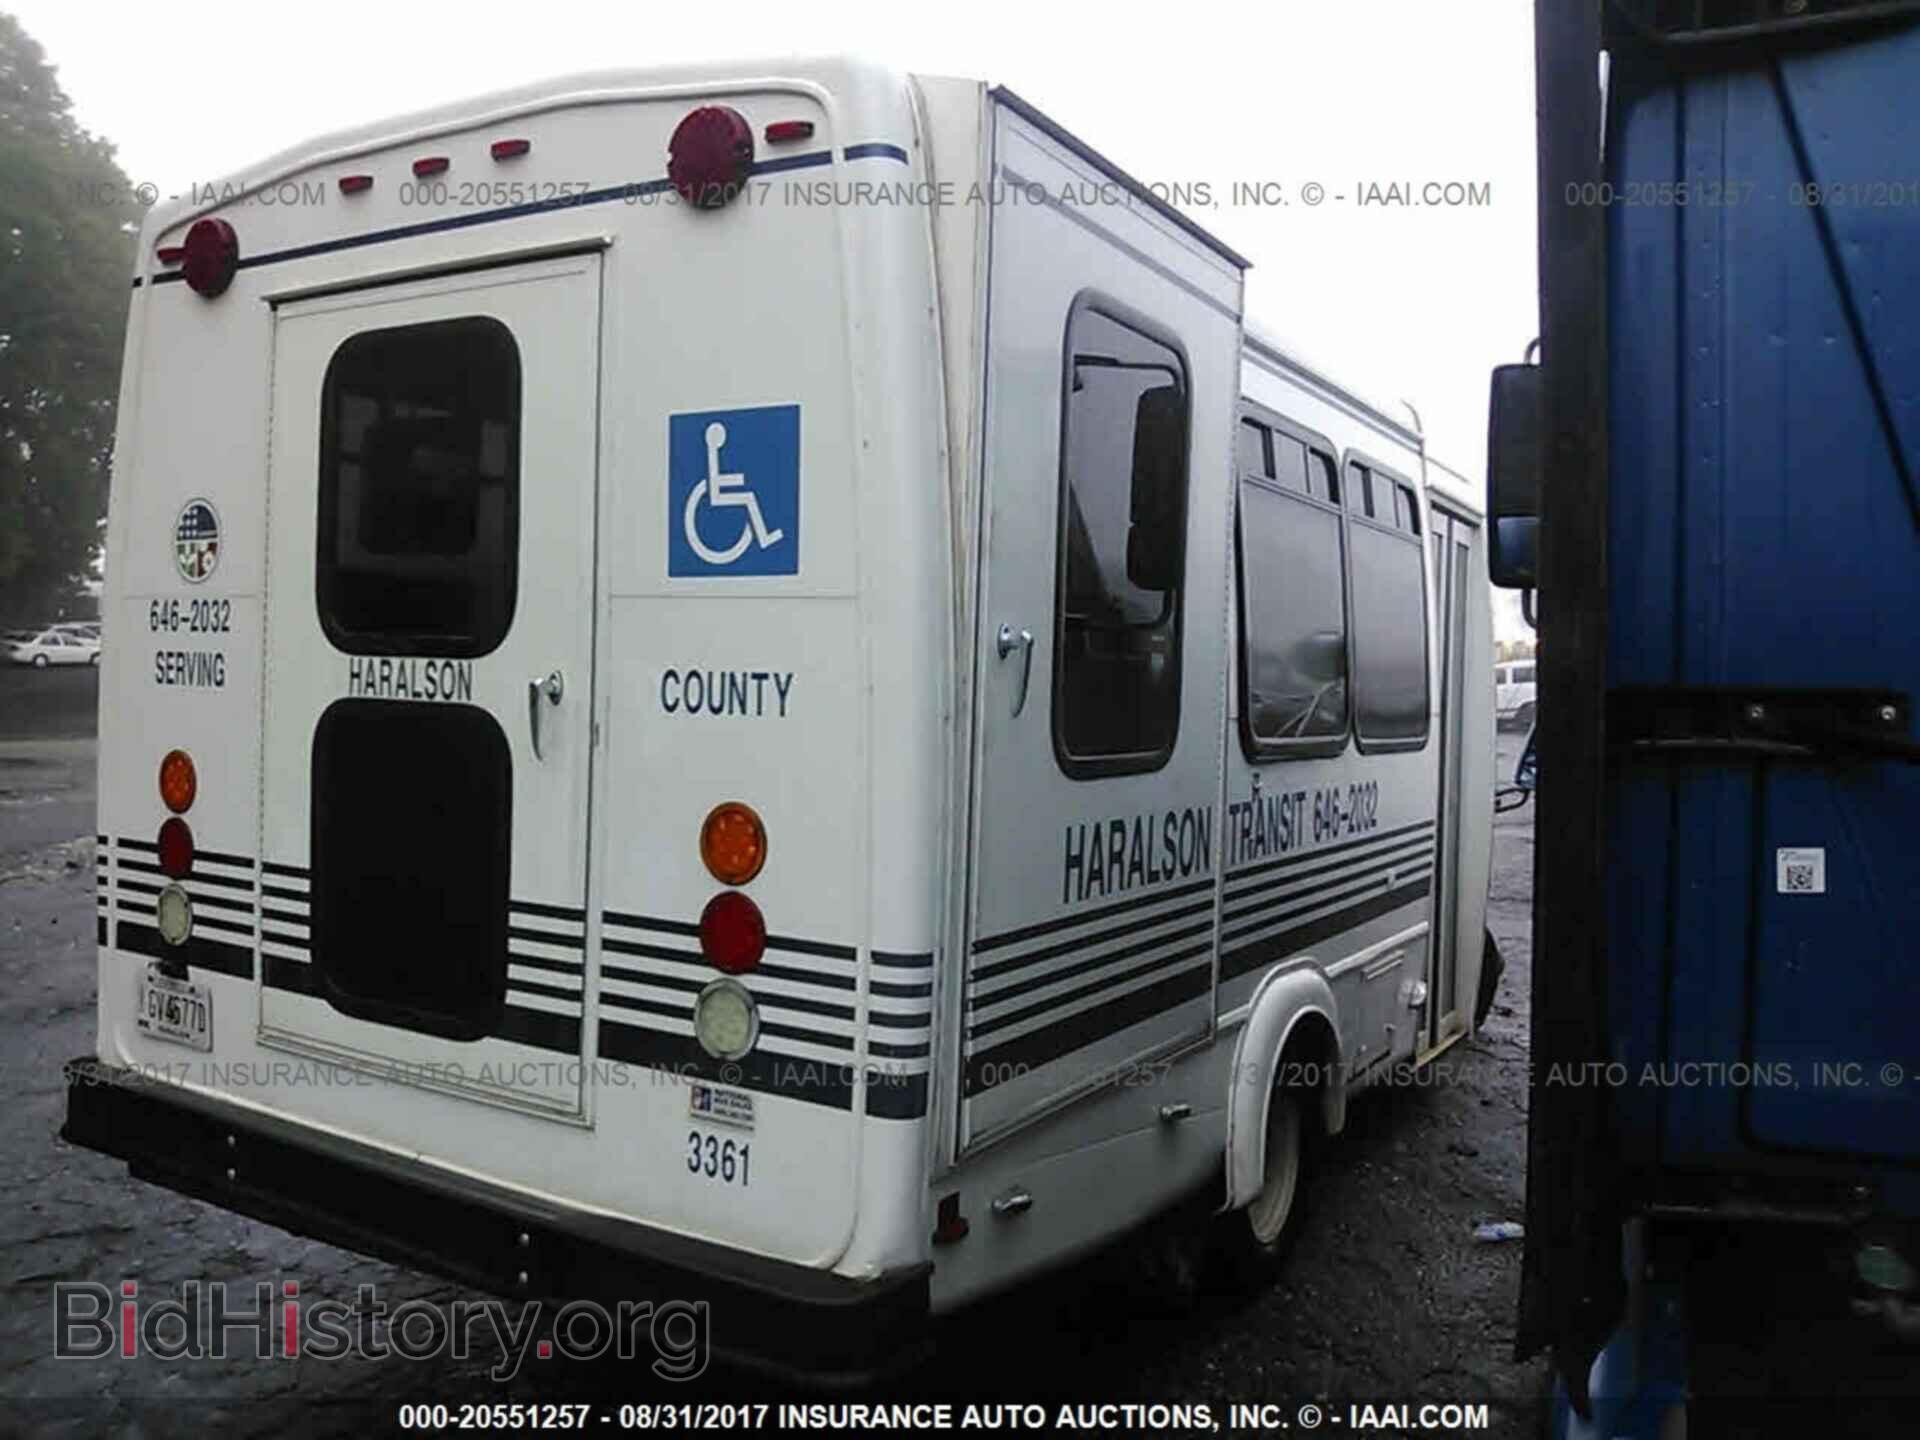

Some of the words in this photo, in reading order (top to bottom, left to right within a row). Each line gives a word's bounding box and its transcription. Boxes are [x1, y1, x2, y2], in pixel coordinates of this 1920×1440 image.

[150, 600, 230, 632] 646-2032
[155, 650, 225, 688] SERVING
[349, 657, 473, 701] HARALSON
[661, 669, 793, 717] COUNTY
[1064, 806, 1212, 904] HARALSON
[1229, 790, 1306, 865] TRANSIT
[687, 1130, 749, 1187] 3361
